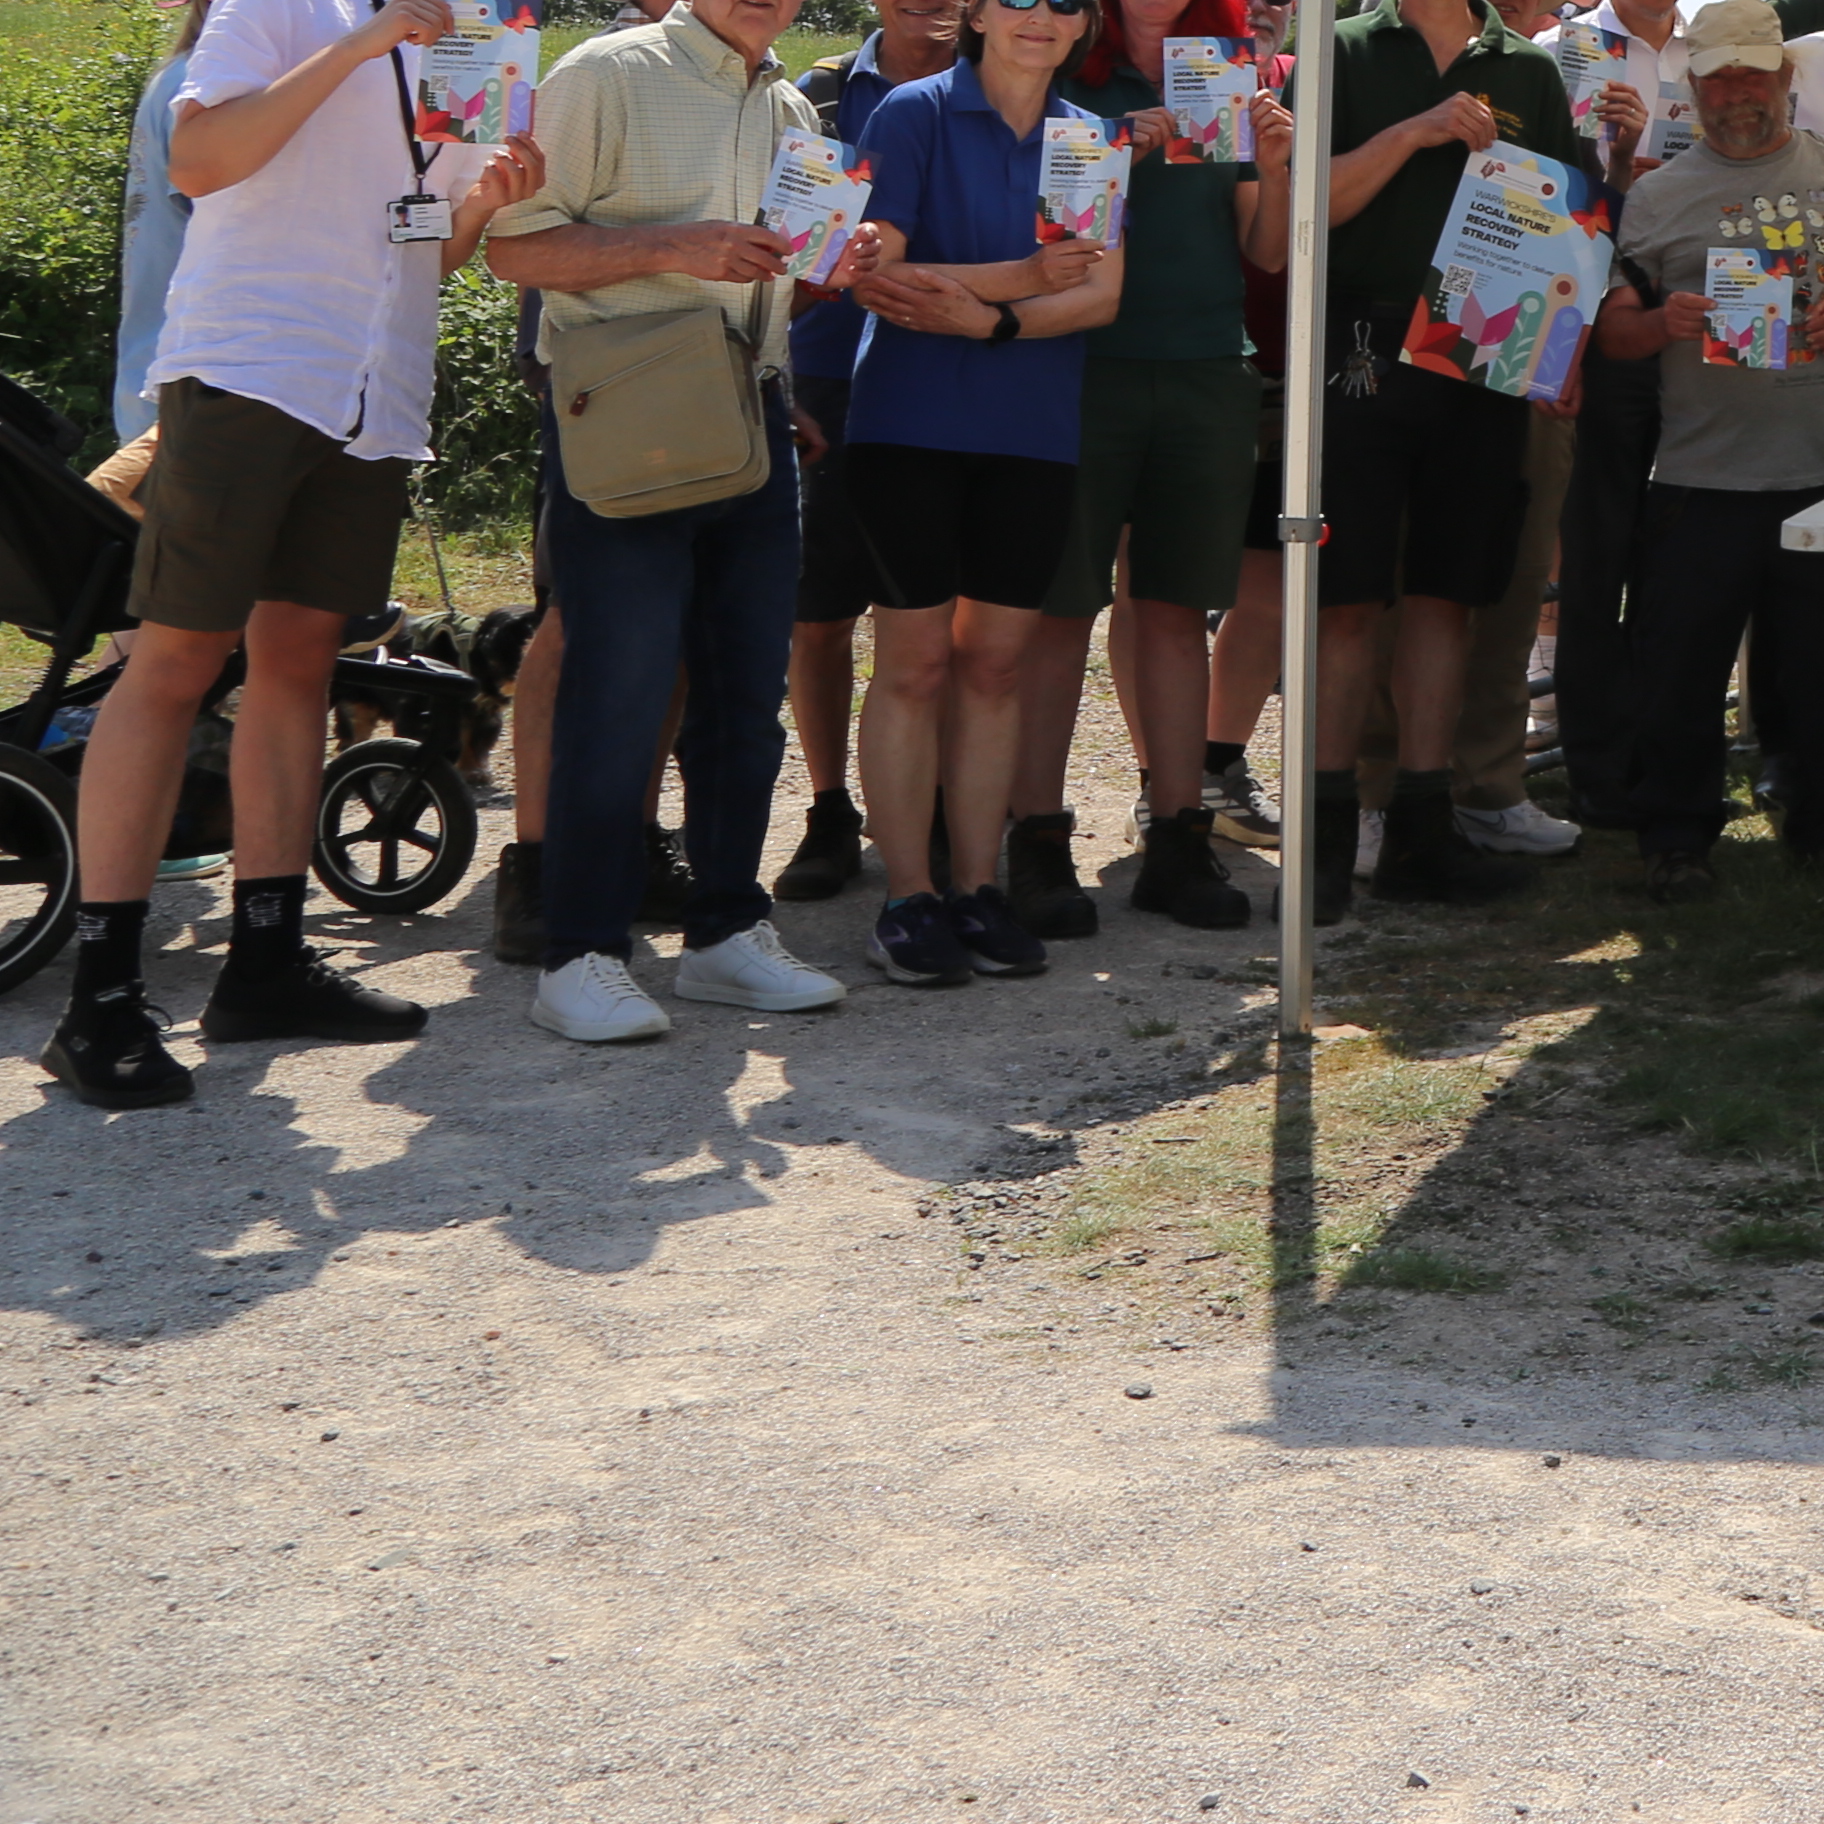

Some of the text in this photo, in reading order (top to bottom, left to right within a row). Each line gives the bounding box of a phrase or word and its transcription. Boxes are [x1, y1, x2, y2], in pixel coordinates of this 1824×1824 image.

[1465, 214, 1525, 238] RECOVERY
[1470, 201, 1552, 234] LOCAL NATURE
[1462, 226, 1520, 251] STRATEGY
